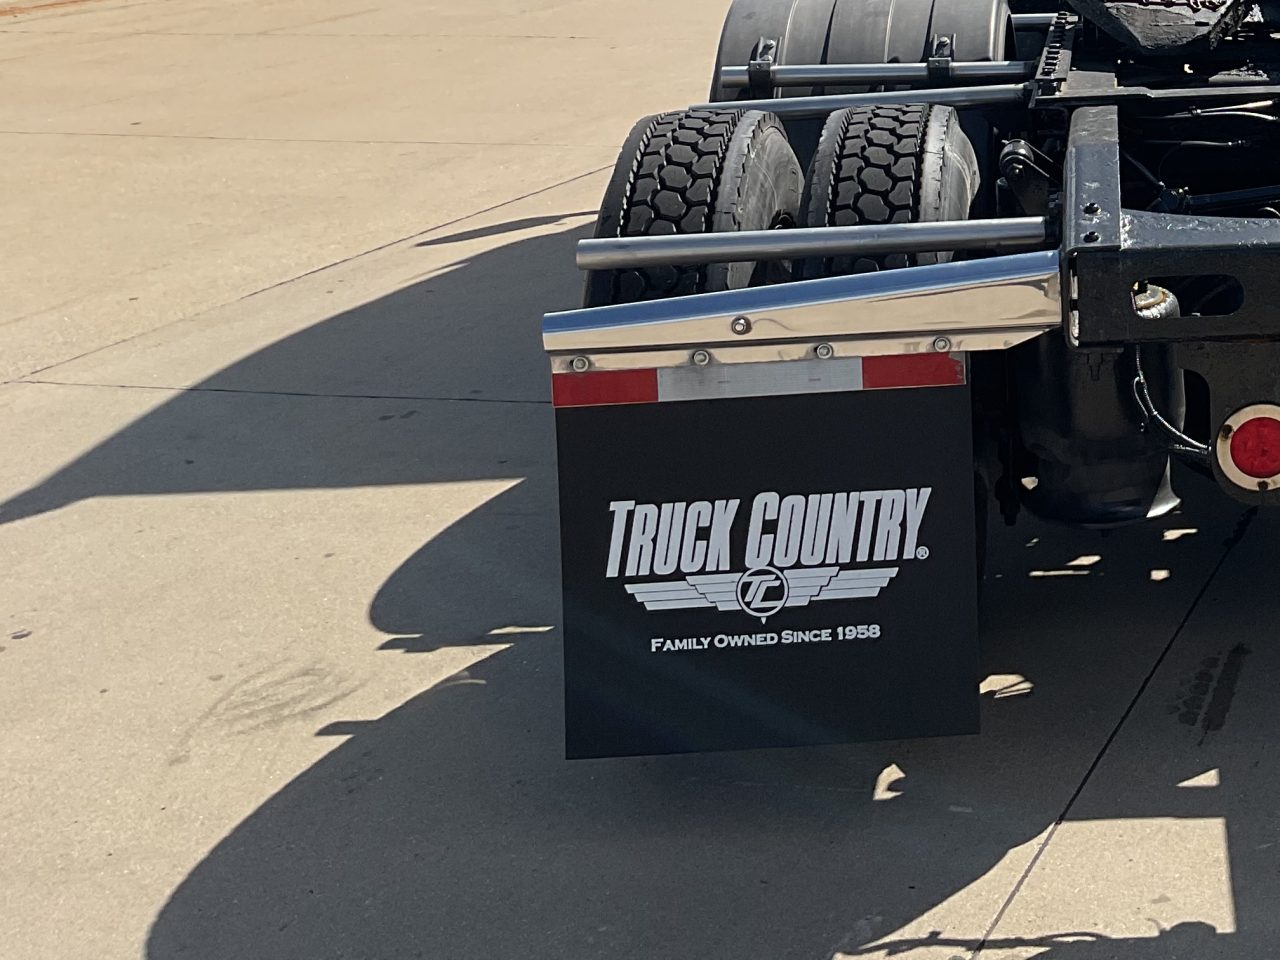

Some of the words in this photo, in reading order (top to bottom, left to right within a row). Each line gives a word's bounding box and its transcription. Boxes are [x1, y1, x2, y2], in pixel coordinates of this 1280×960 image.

[606, 499, 740, 578] TRUCK
[745, 487, 932, 569] COUNTRY
[651, 636, 711, 652] FAMILY
[713, 632, 778, 648] OWNED
[781, 628, 832, 644] SINCE
[836, 624, 881, 640] 1958
